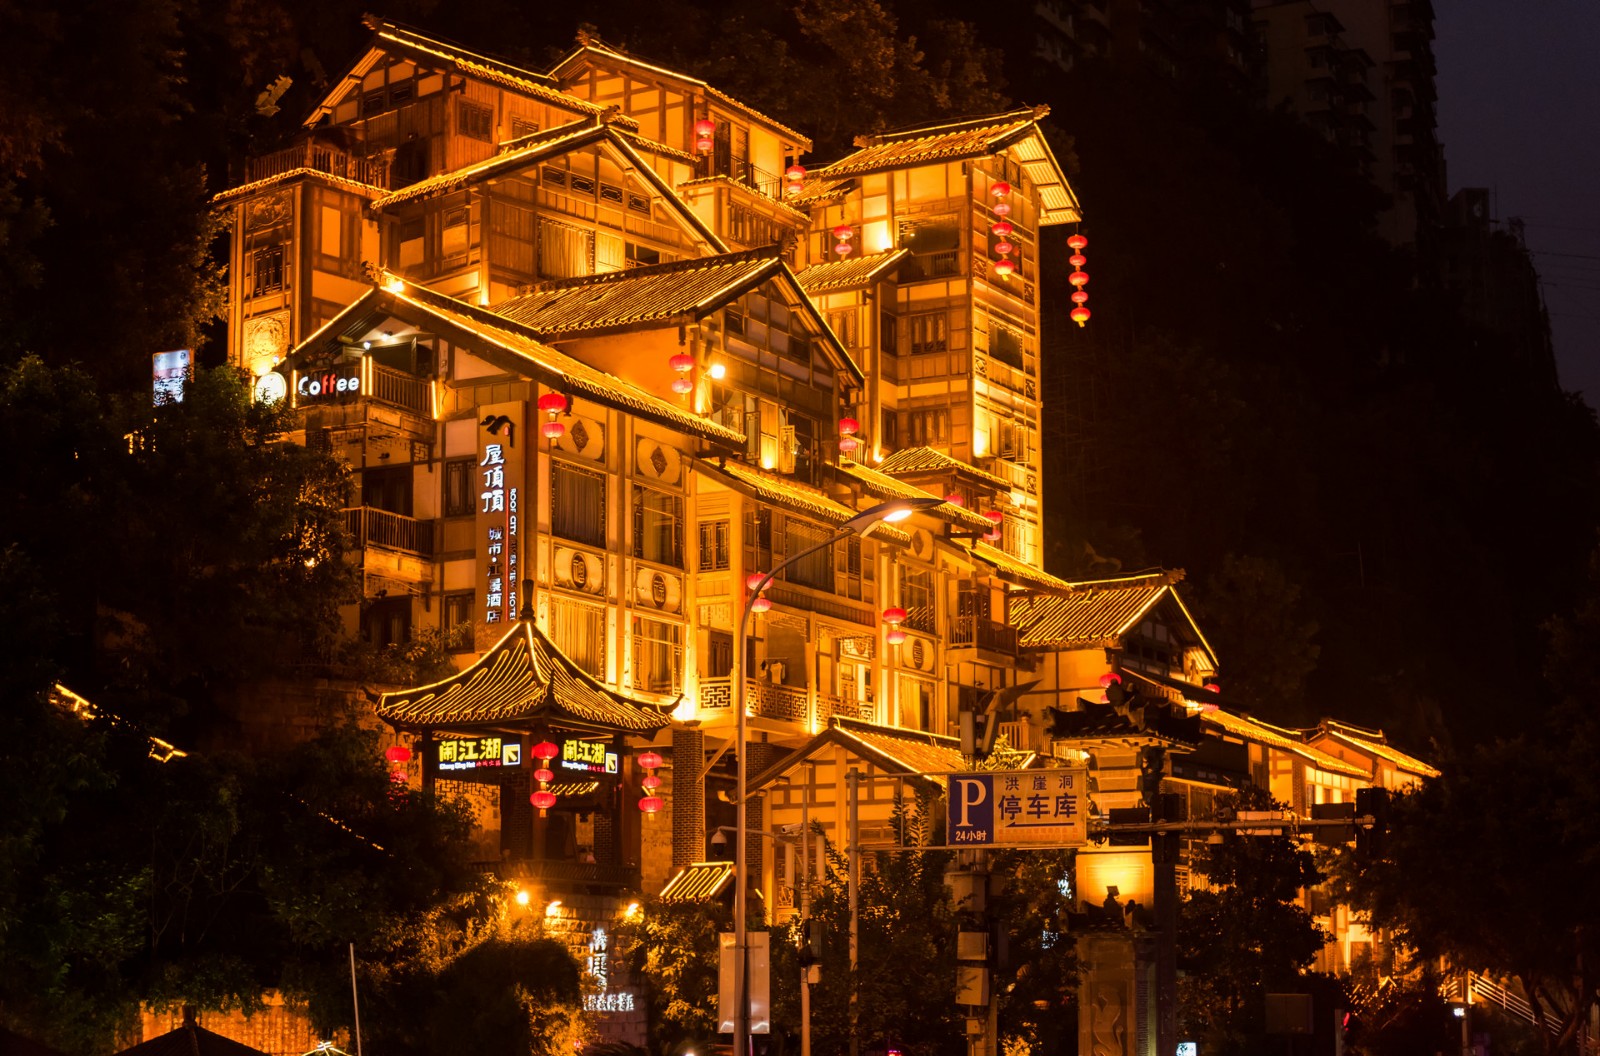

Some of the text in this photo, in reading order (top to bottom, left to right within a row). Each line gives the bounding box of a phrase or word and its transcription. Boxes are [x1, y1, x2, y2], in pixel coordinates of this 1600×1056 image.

[298, 373, 359, 396] Coffee
[439, 738, 502, 762] 闹江湖
[563, 739, 605, 764] 闹江湖
[1005, 774, 1074, 791] 洪崖洞
[956, 779, 987, 827] P
[998, 792, 1078, 820] 停车库
[955, 830, 987, 842] 24小时
